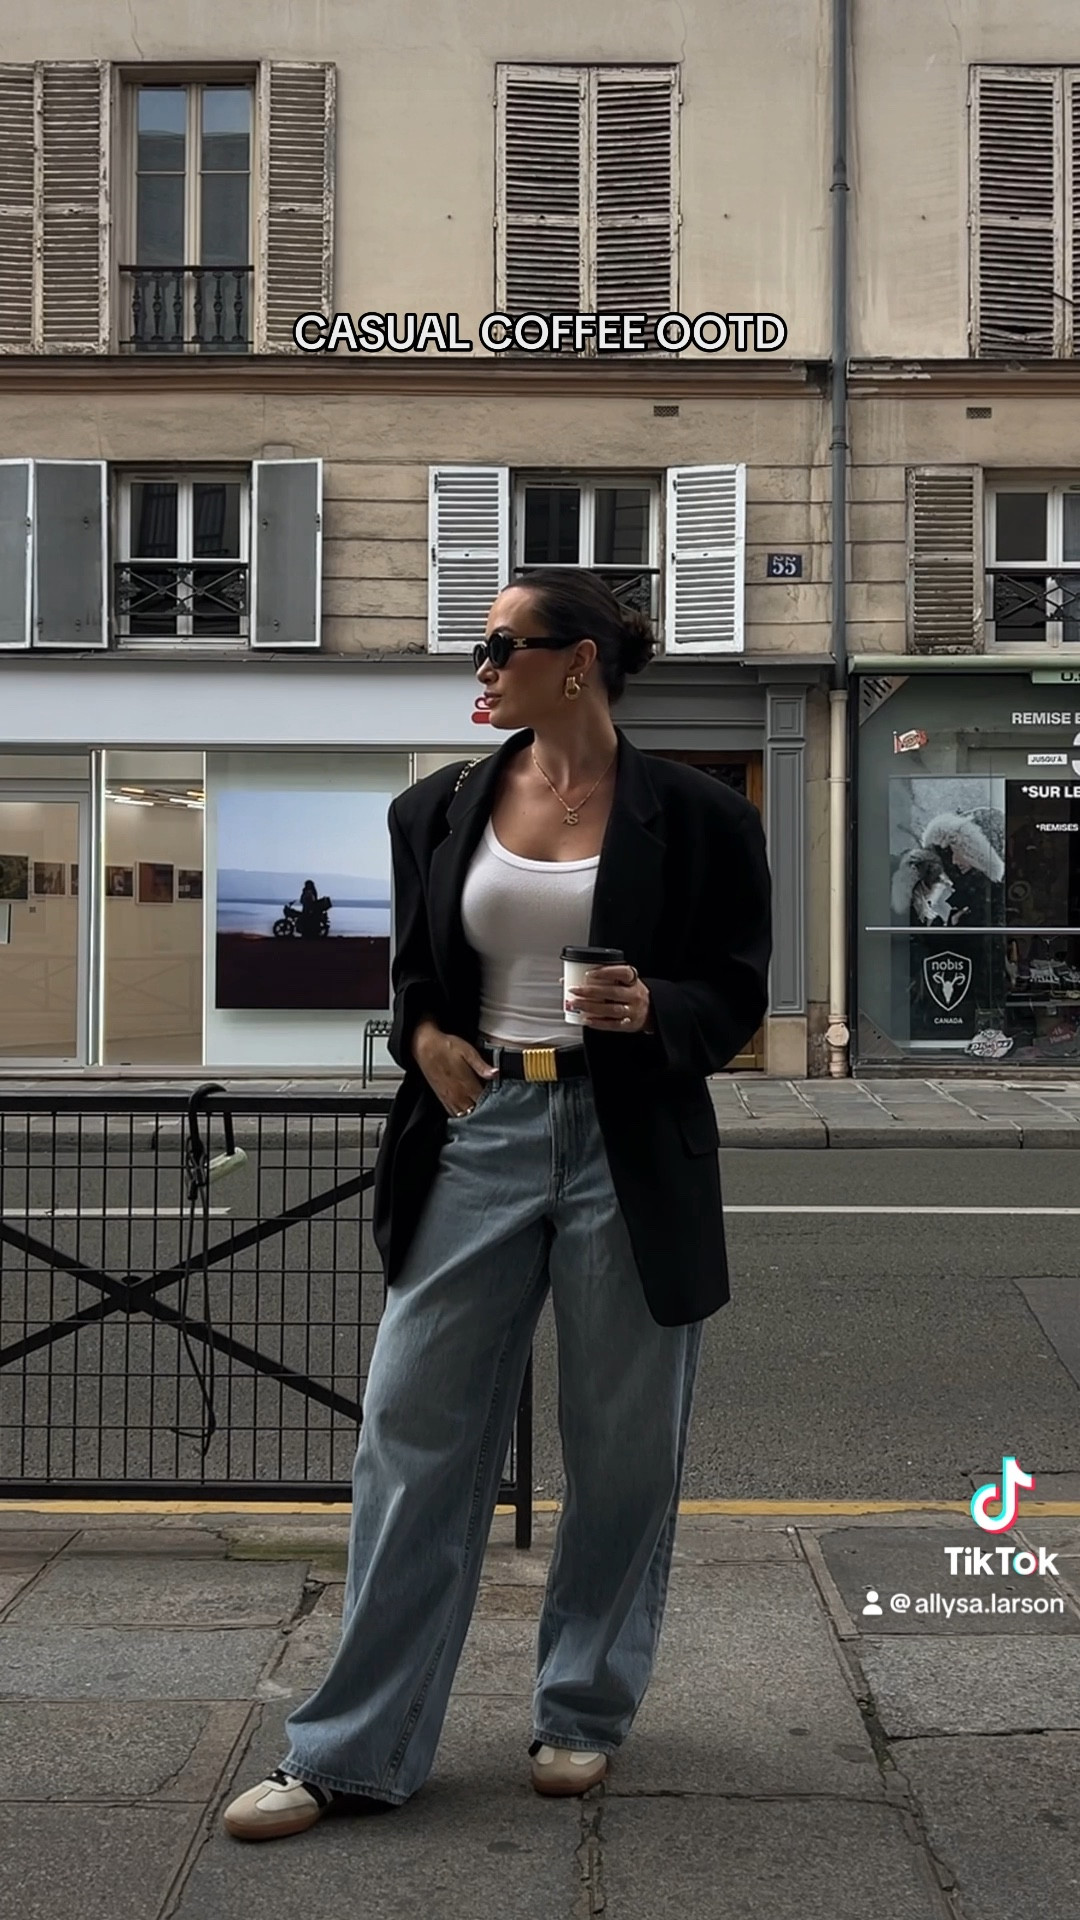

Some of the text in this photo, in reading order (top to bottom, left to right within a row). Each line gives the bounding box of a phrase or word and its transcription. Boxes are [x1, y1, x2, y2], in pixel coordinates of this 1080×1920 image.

[773, 556, 797, 575] 55
[1012, 712, 1071, 725] REMISE
[931, 958, 964, 971] nobis
[933, 1017, 963, 1025] CANADA
